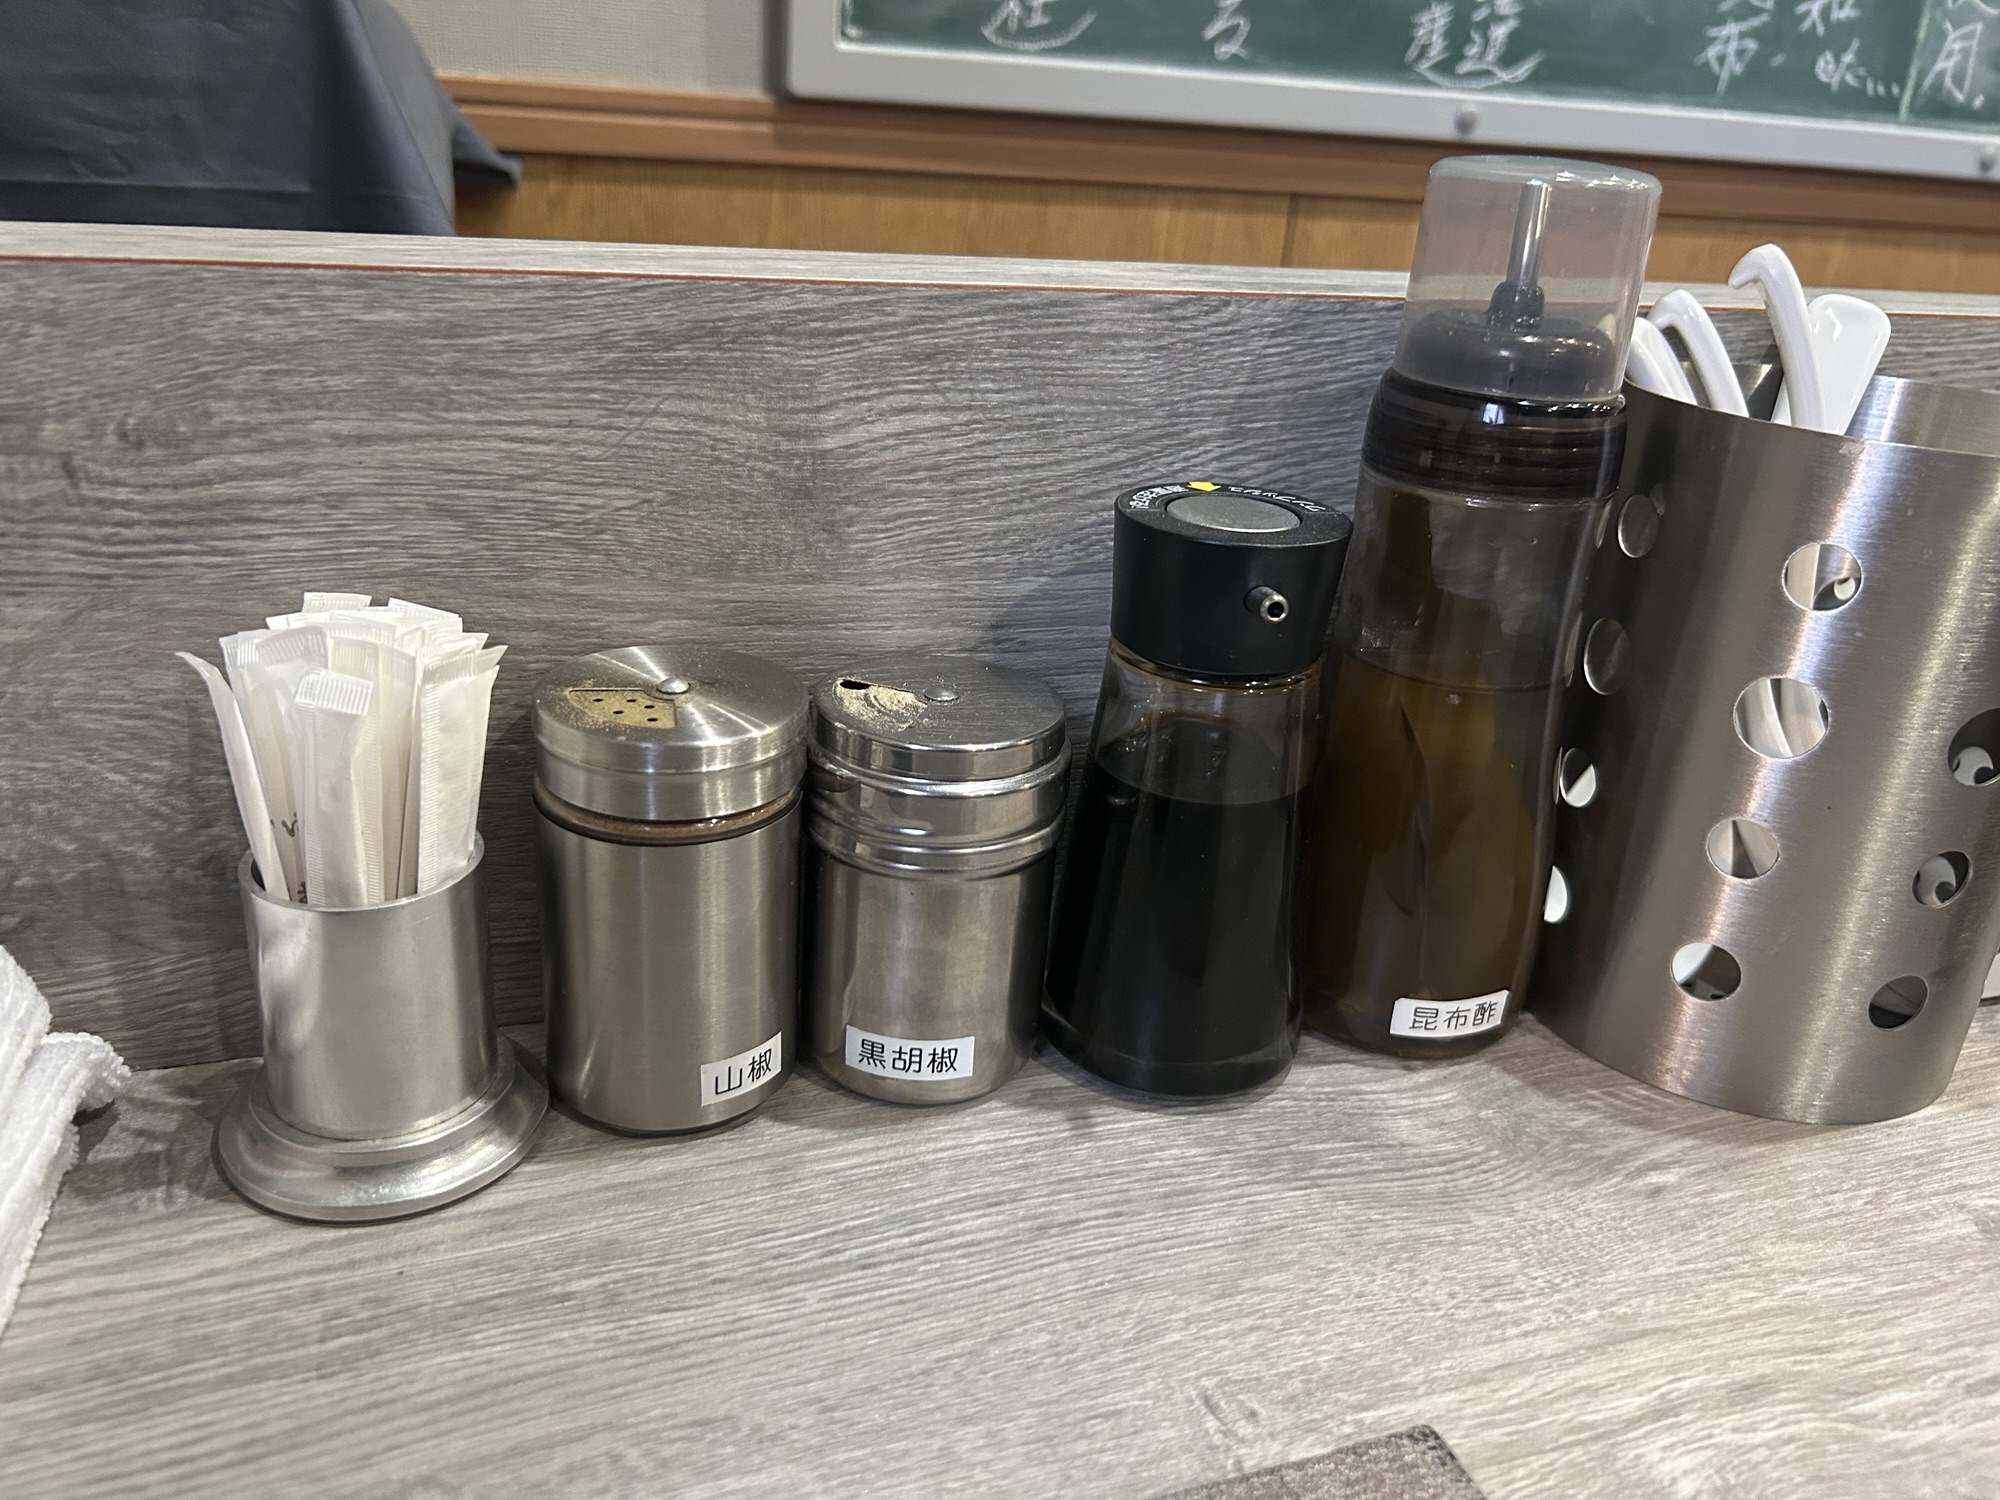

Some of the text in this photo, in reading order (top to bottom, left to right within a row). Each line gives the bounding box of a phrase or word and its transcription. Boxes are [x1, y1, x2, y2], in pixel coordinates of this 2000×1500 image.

[1408, 1000, 1498, 1031] 昆布酢
[714, 1048, 773, 1096] 山椒
[858, 1038, 959, 1075] 黒胡椒
